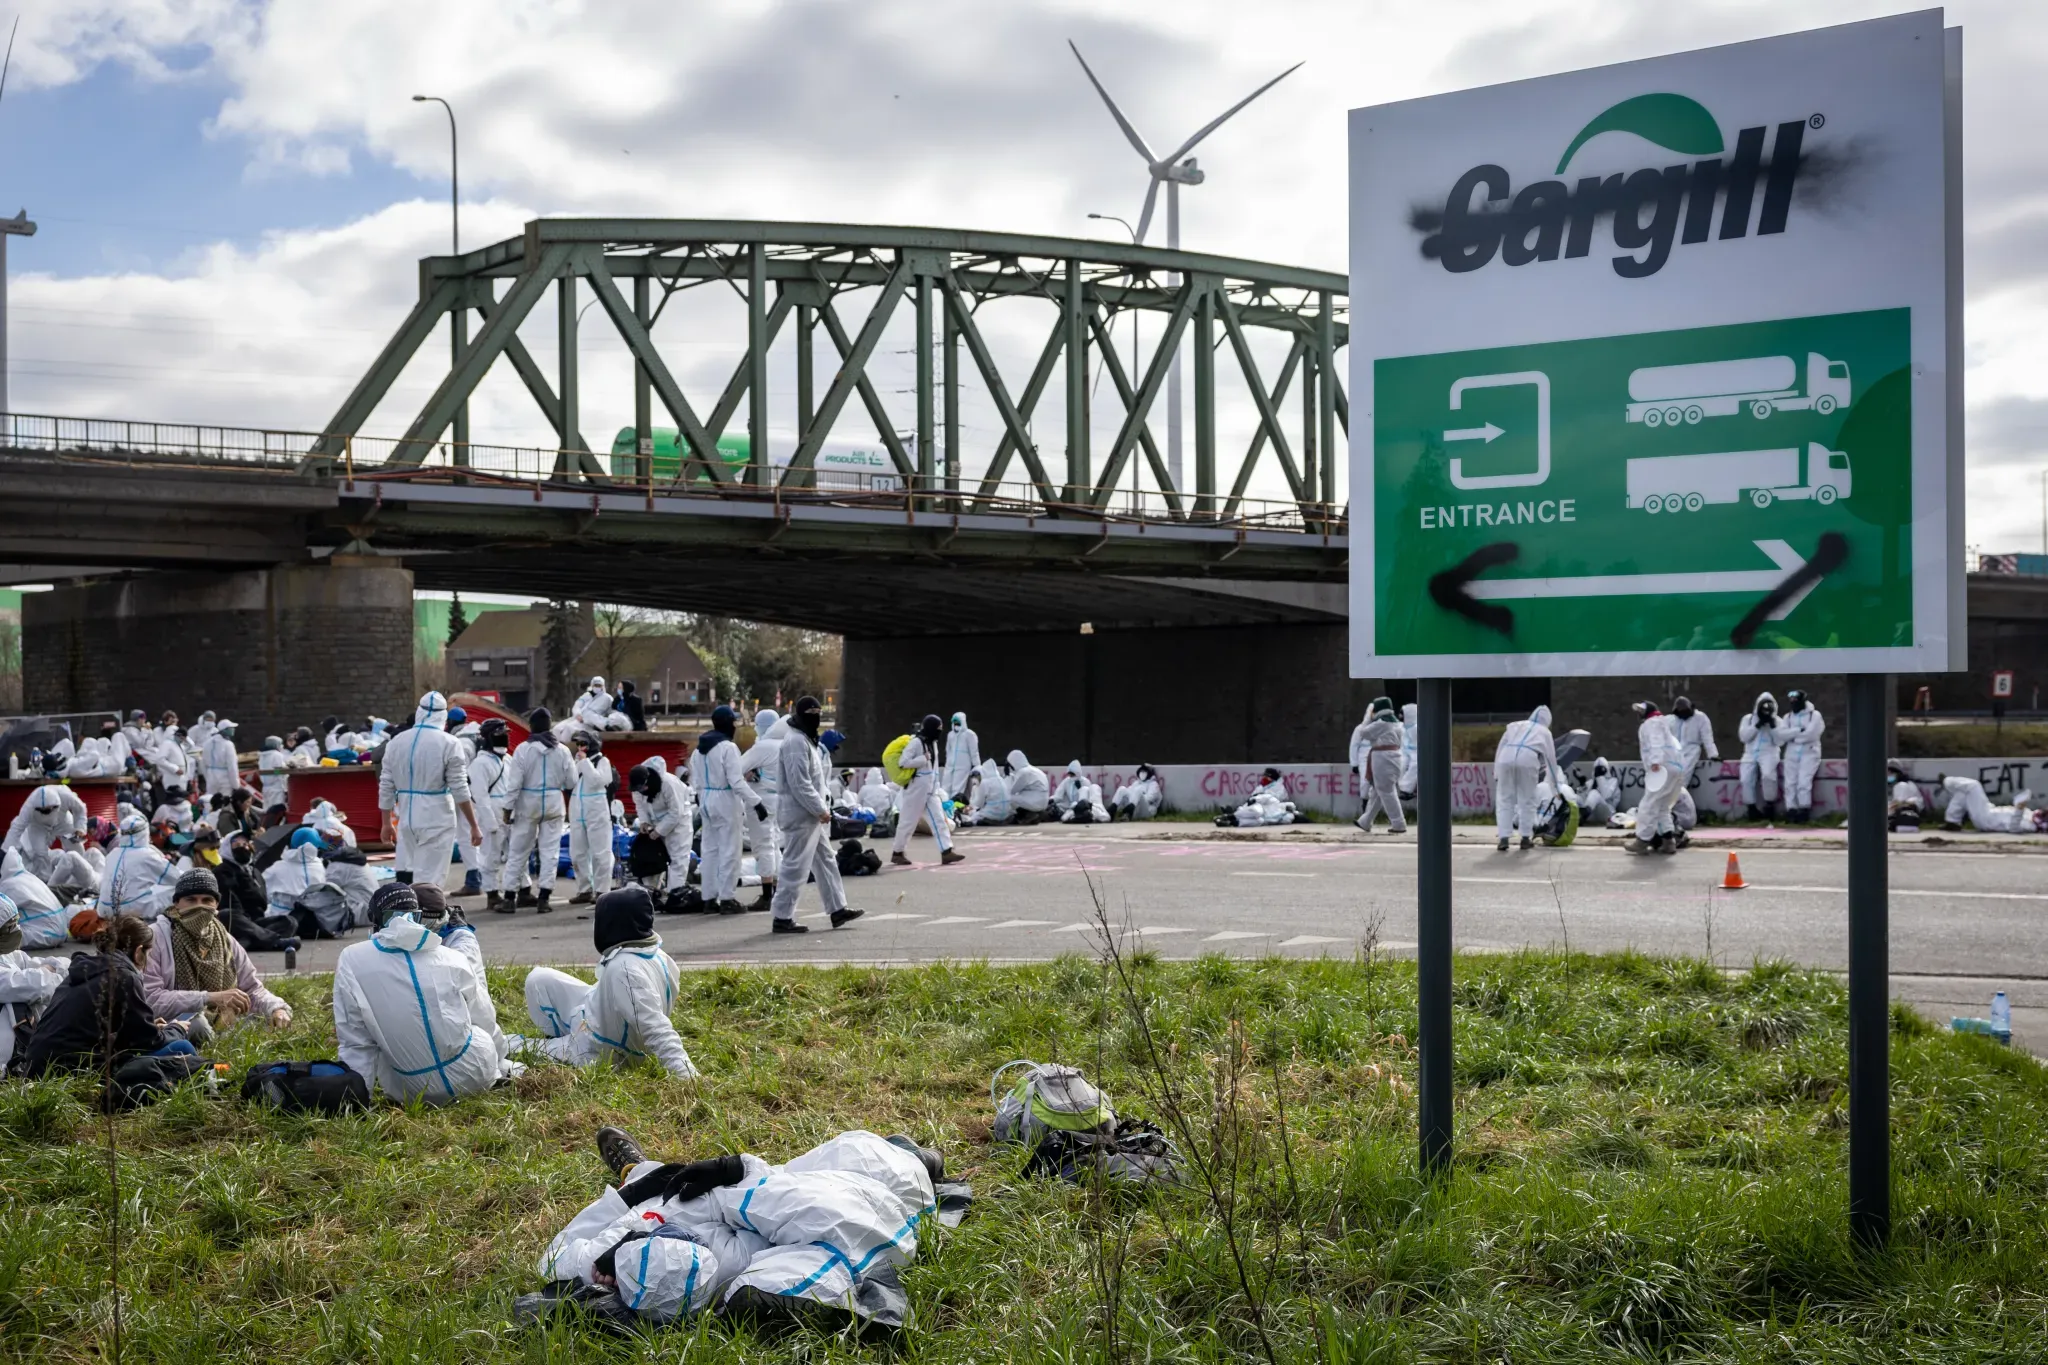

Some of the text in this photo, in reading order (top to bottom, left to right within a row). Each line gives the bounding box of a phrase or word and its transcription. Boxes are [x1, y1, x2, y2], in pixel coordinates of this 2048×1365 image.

[1439, 120, 1807, 278] Cargill
[824, 455, 867, 465] PRODUCTS
[1420, 499, 1576, 529] ENTRANCE
[1314, 773, 1343, 794] THE
[1979, 763, 2030, 796] EAT
